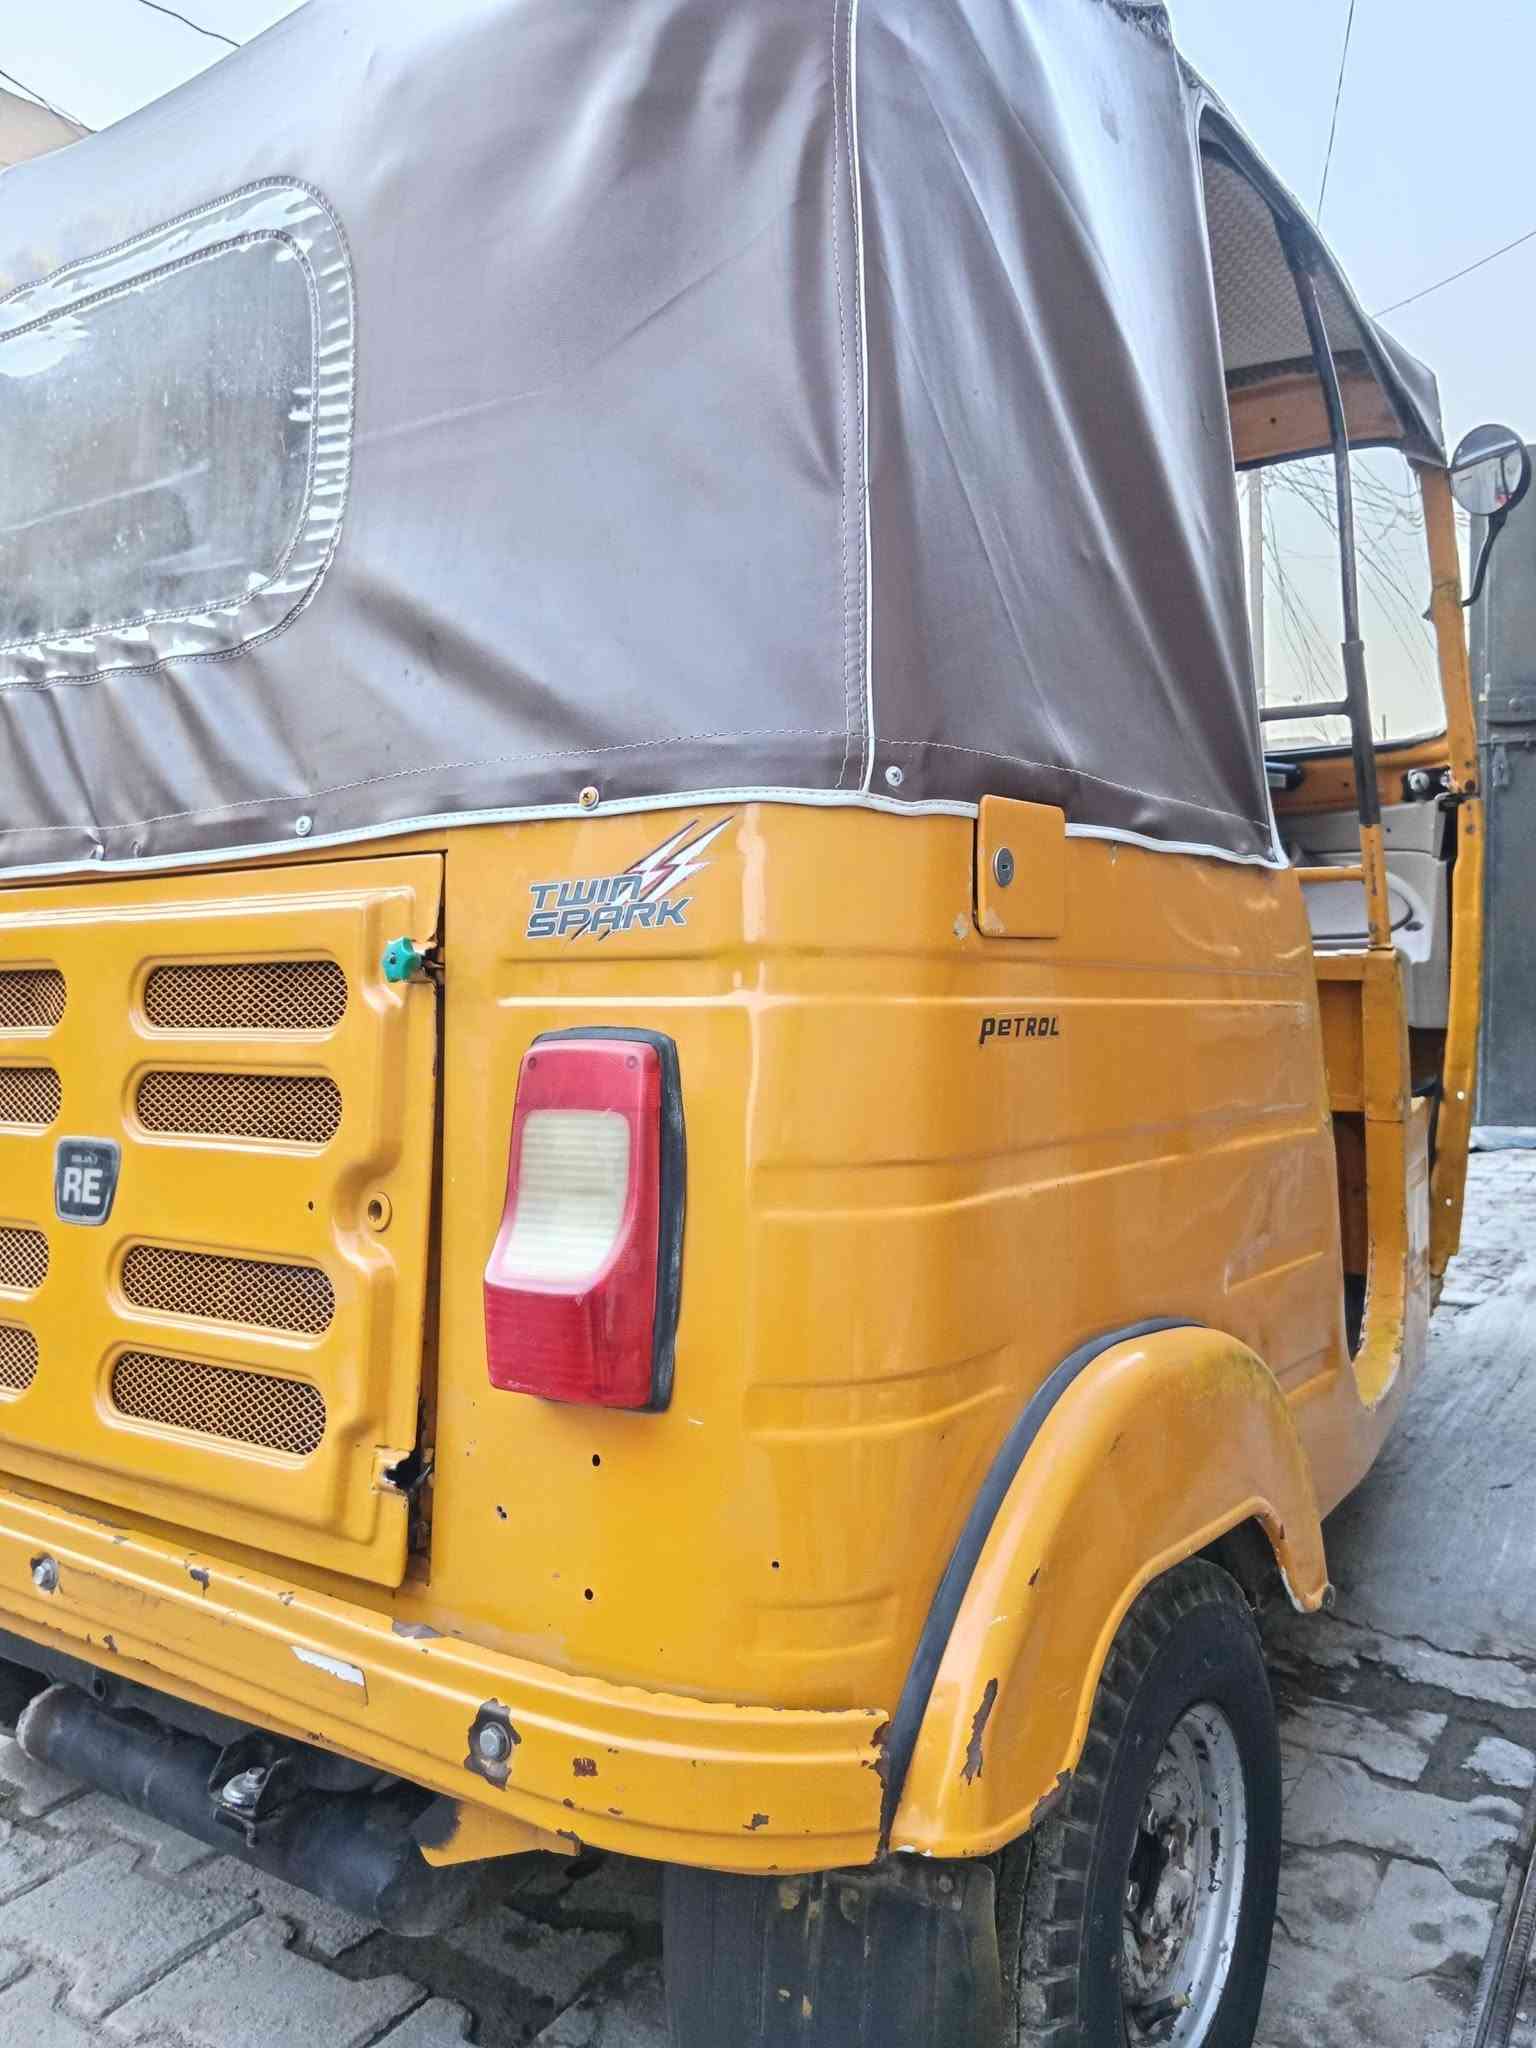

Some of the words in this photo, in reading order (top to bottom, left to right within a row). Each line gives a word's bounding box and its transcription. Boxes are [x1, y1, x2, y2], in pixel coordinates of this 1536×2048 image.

[529, 874, 643, 910] TWIN
[526, 898, 692, 939] SPARK
[63, 1167, 103, 1205] RE
